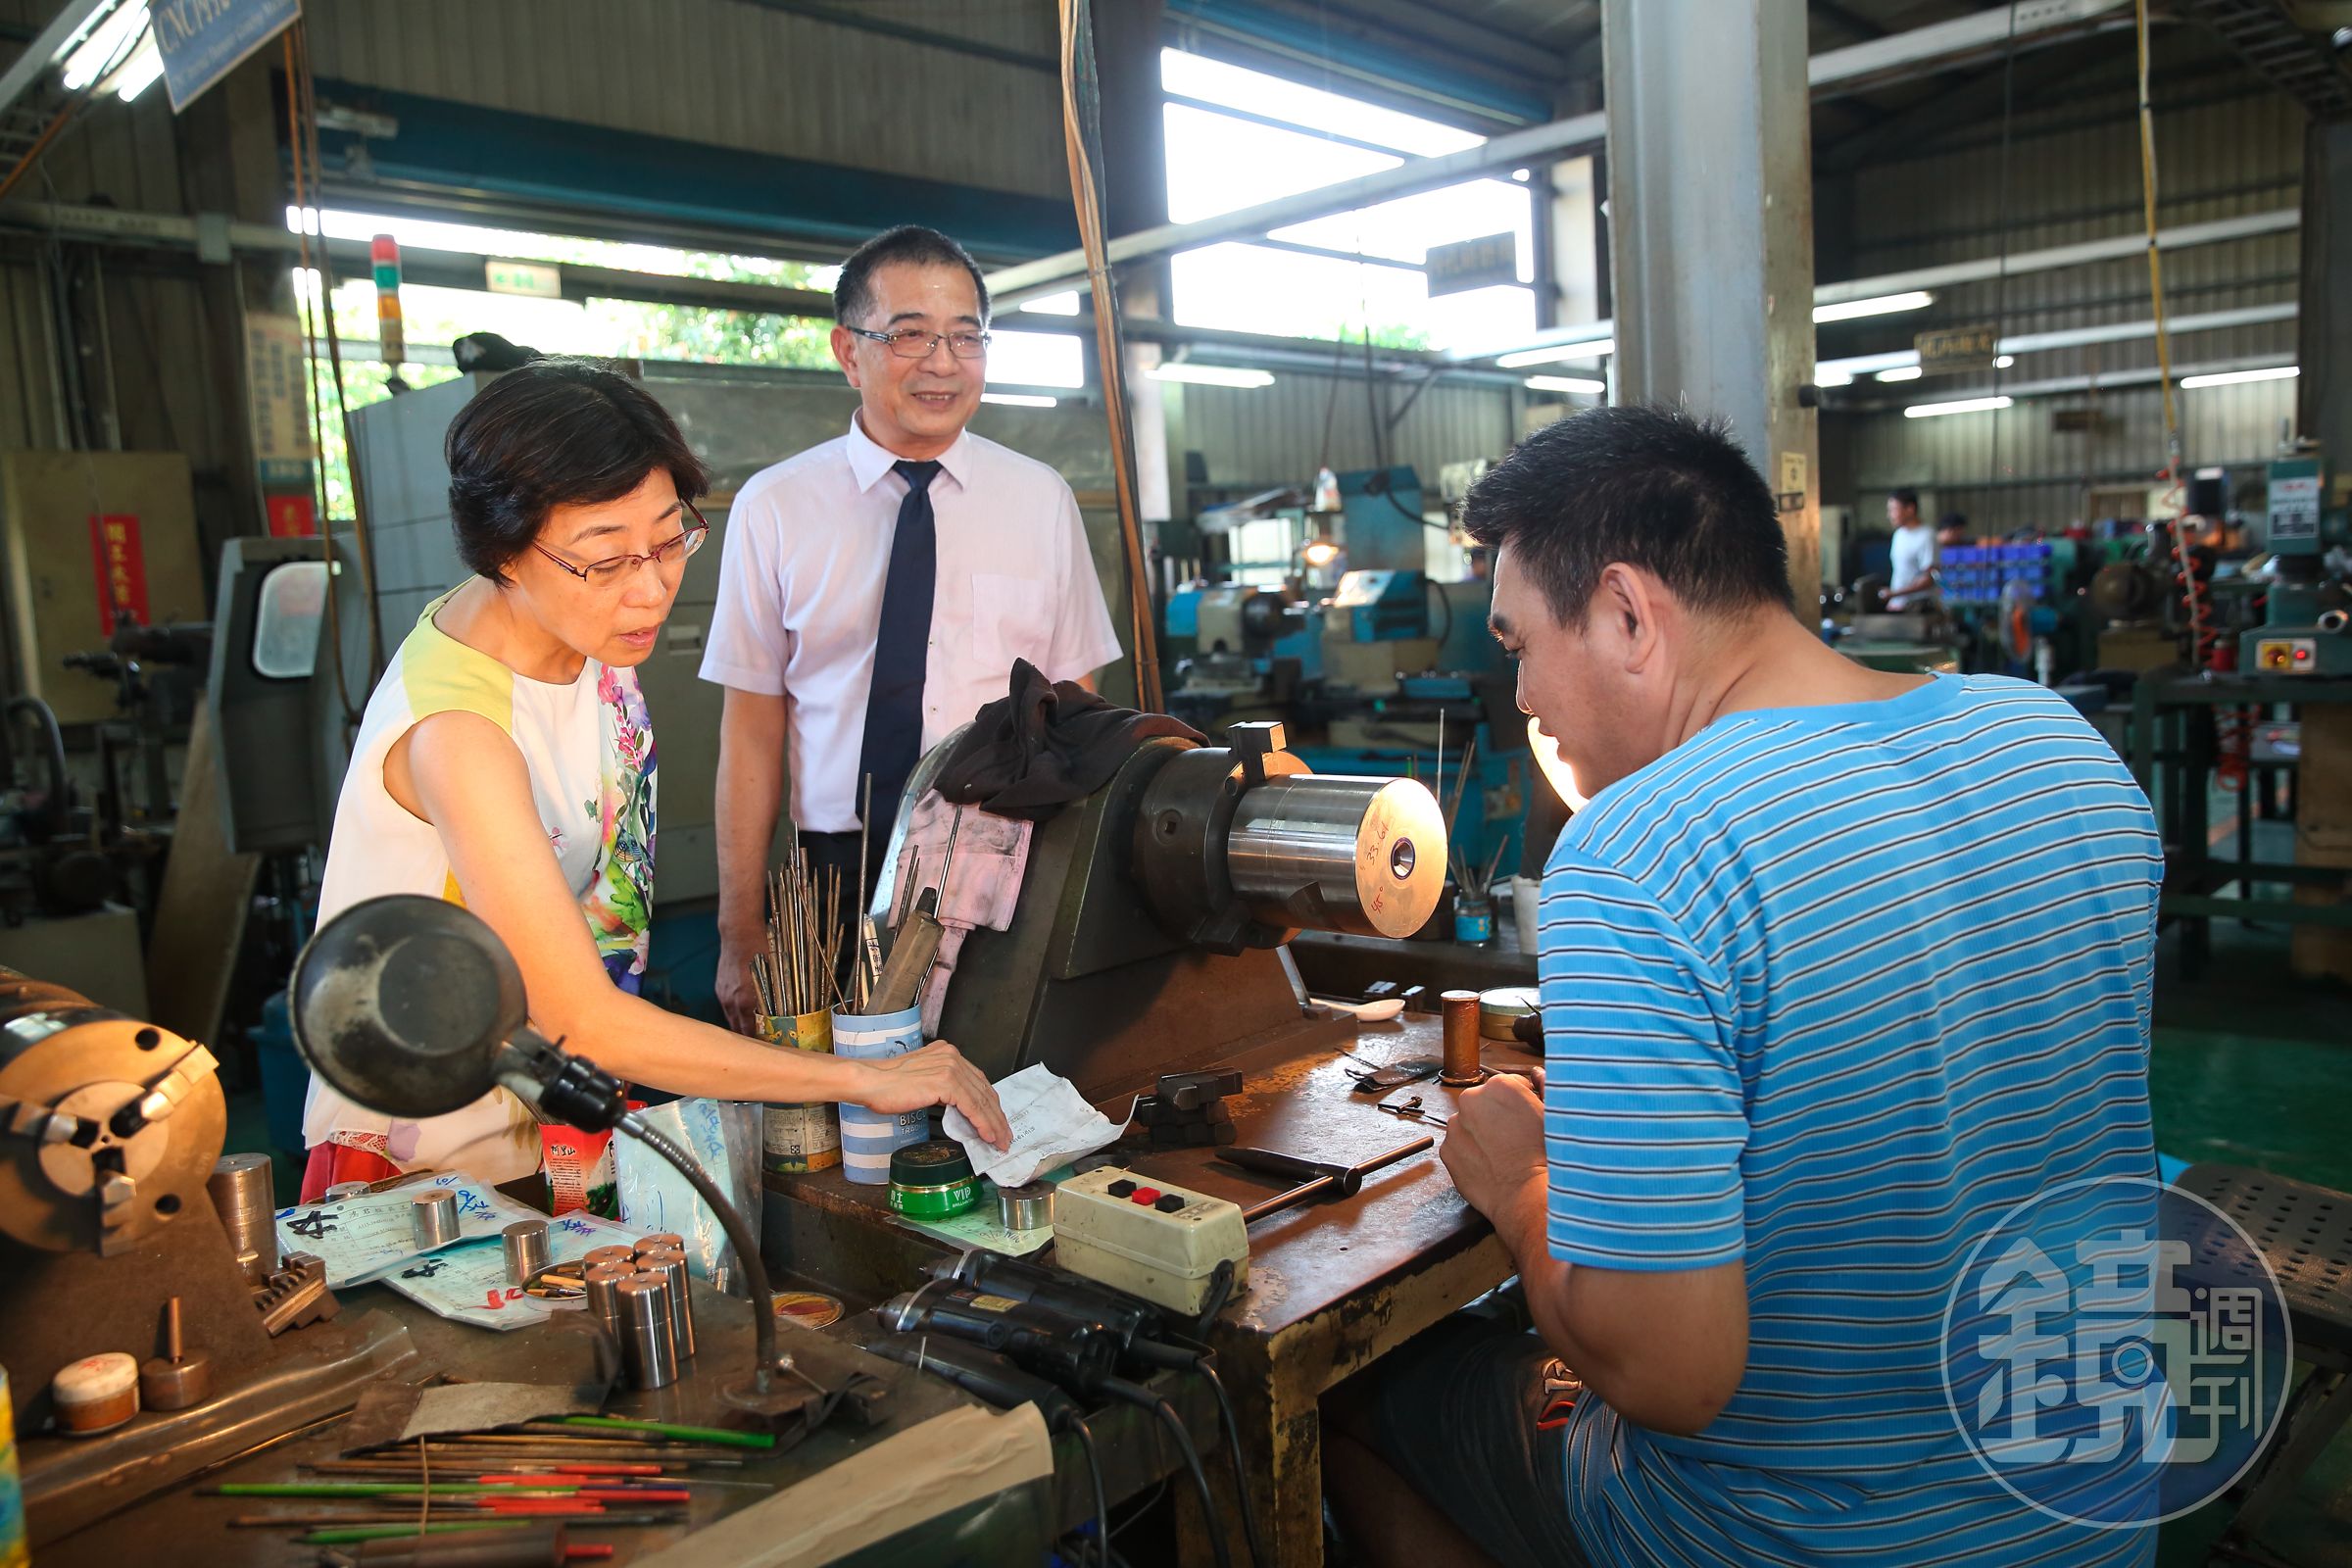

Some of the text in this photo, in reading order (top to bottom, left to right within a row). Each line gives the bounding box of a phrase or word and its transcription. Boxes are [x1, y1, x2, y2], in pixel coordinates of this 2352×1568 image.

[550, 1144, 576, 1156] 阿里山
[953, 1186, 971, 1201] VIP
